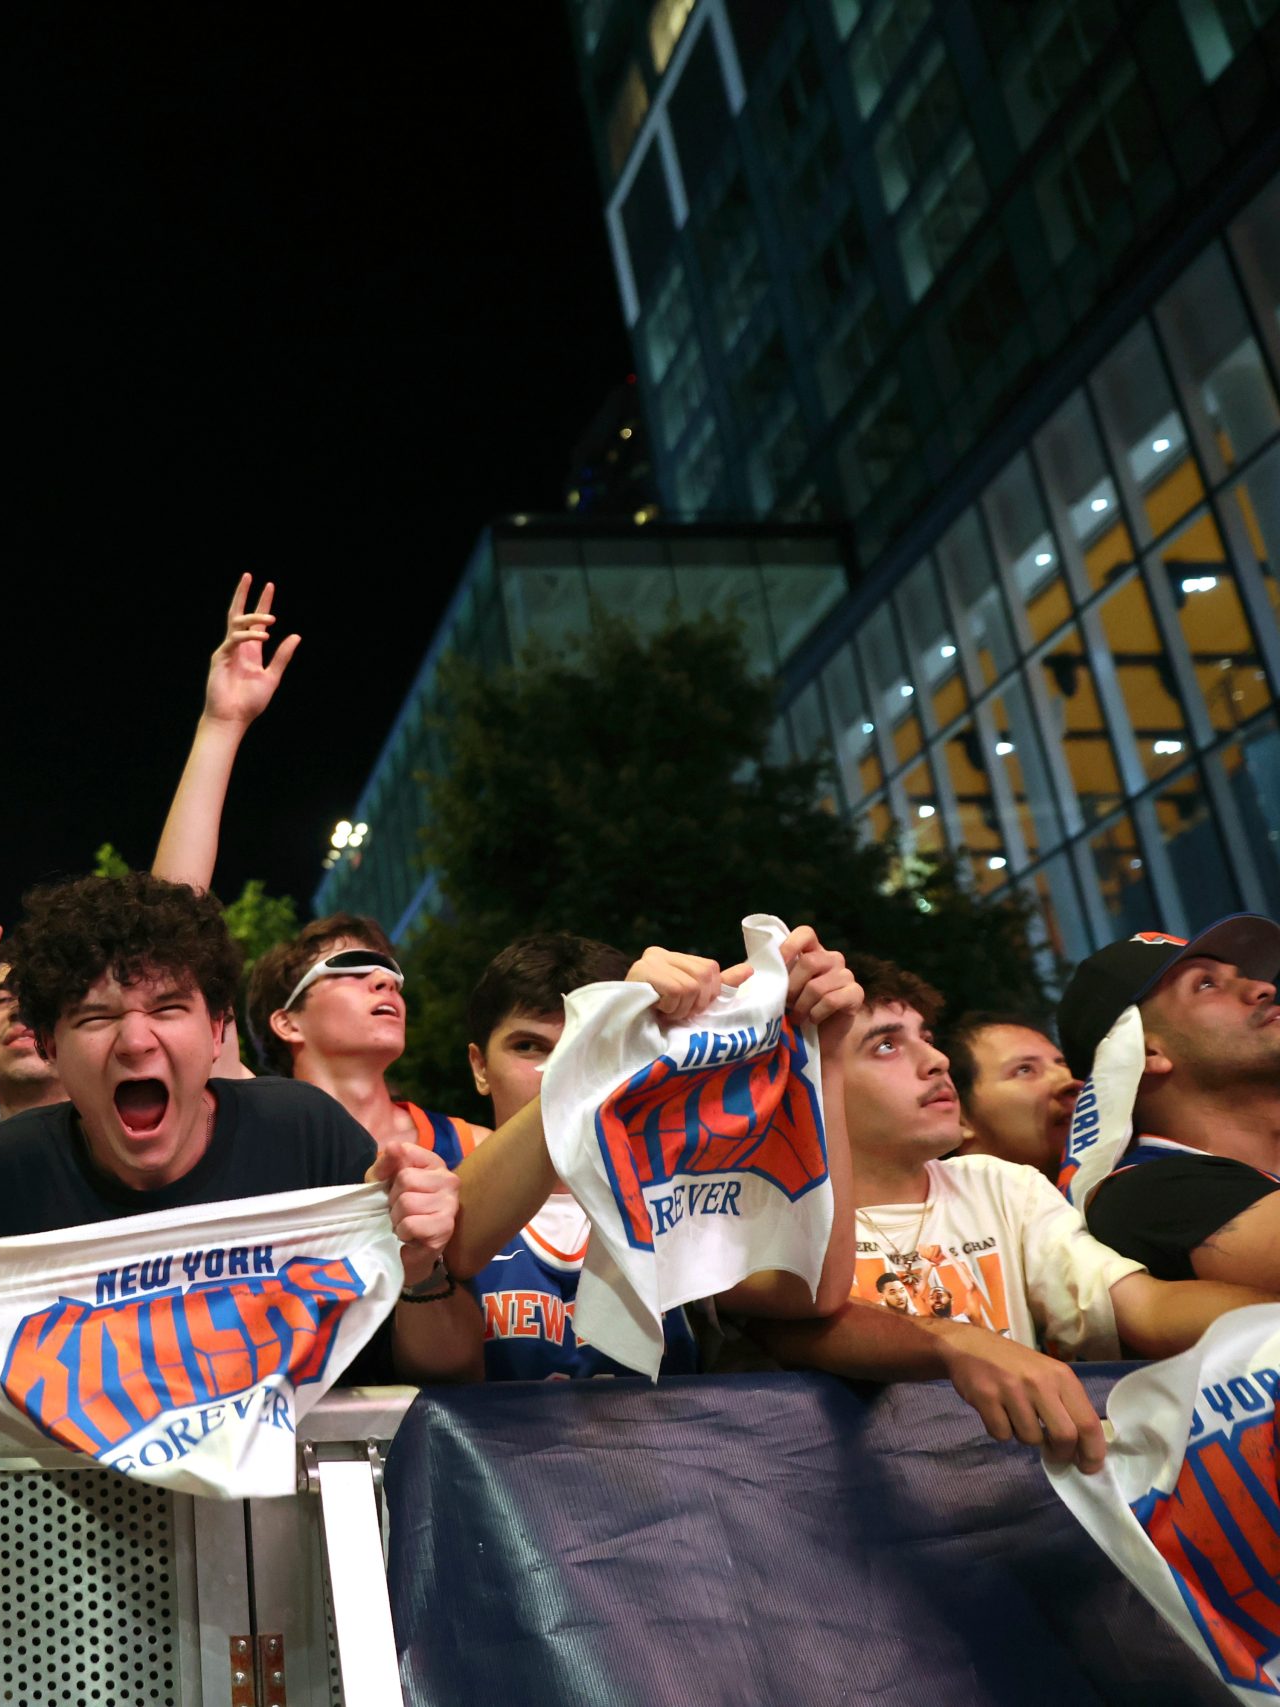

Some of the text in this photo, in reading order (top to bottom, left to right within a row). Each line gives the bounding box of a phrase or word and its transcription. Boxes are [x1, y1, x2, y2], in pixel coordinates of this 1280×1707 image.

[649, 1181, 742, 1236] REVER
[95, 1245, 276, 1306] NEW YORK
[481, 1289, 566, 1347] NEW
[1200, 1366, 1280, 1422] YOR
